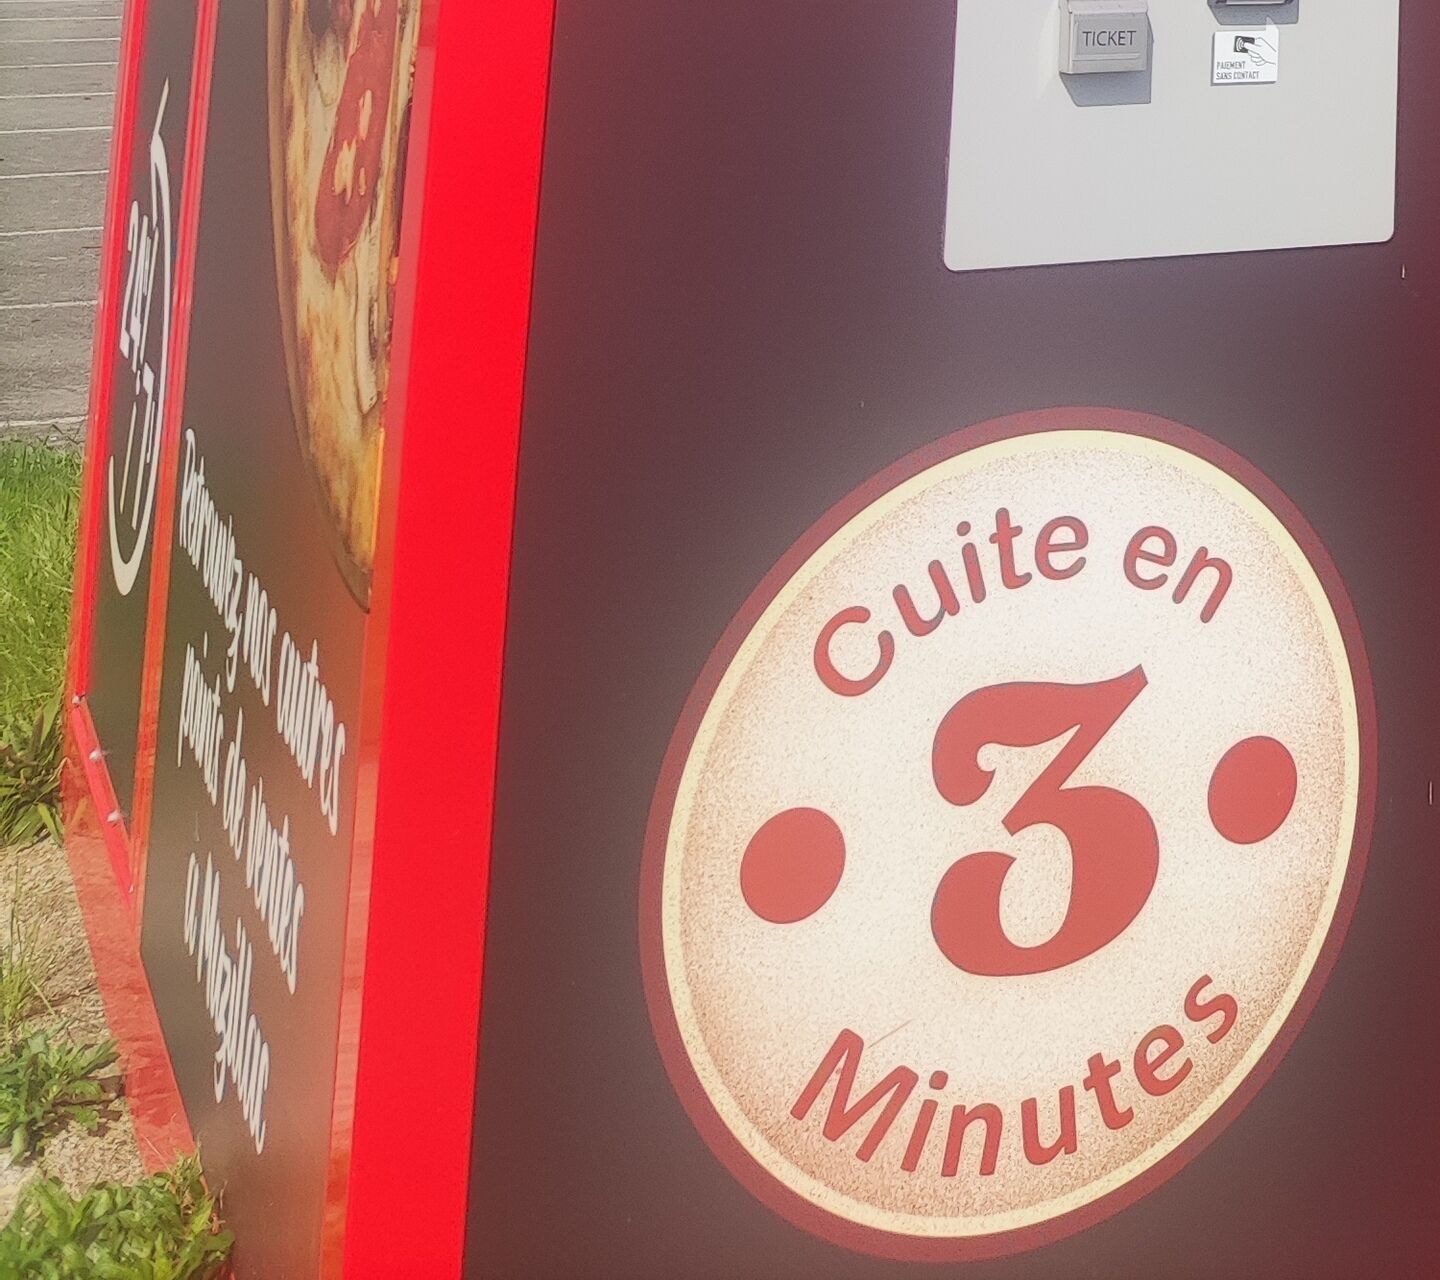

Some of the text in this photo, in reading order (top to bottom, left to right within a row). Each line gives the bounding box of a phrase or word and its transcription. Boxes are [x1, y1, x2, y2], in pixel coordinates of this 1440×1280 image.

[1083, 30, 1137, 47] TICKET
[1216, 60, 1246, 70] PAIEMENT
[1216, 70, 1260, 80] SANS CONTACT
[179, 427, 345, 836] Retrouvez nos autres
[813, 507, 1233, 697] Cuite en
[177, 632, 304, 995] points de ventes
[930, 663, 1160, 977] 3
[790, 973, 1239, 1177] Minutes
